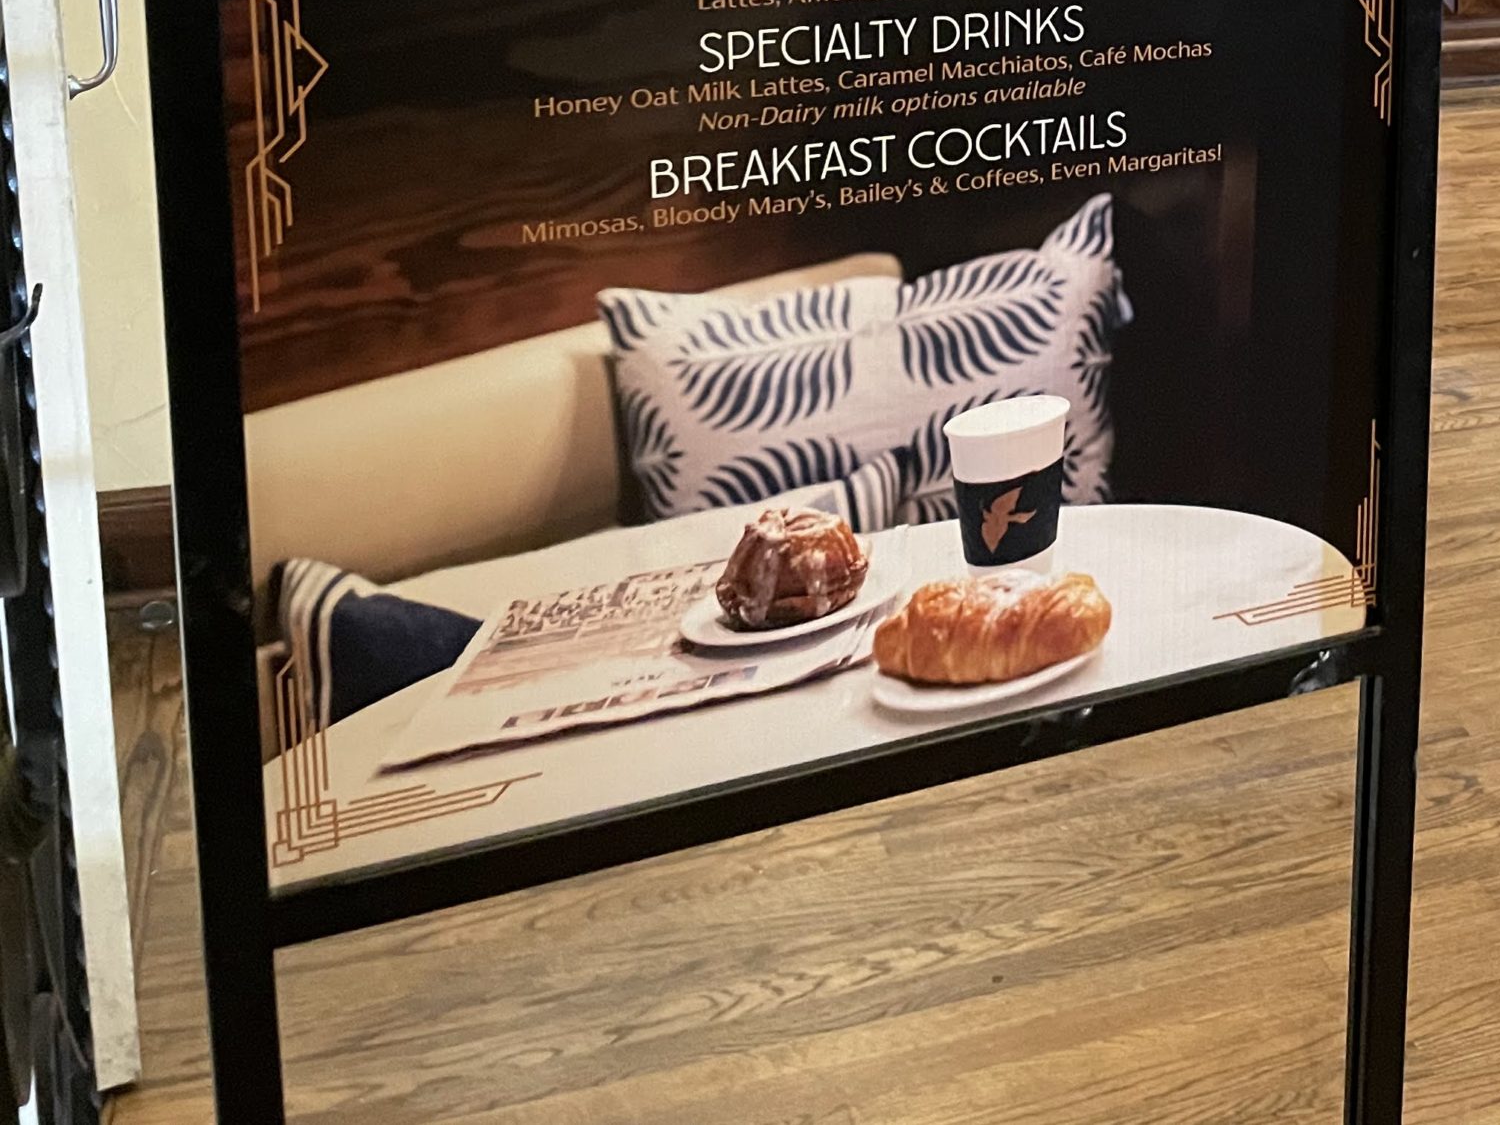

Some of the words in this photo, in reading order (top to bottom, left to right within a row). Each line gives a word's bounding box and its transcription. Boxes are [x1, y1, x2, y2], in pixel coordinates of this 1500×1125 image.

[699, 17, 917, 73] SPECIALTY
[933, 5, 1084, 53] DRINKS
[535, 96, 622, 117] Honey
[631, 87, 679, 108] Oat
[688, 81, 742, 103] Milk
[751, 77, 830, 97] Lattes,
[838, 63, 933, 89] Caramel
[942, 55, 1072, 80] Macchiatos,
[1080, 46, 1126, 67] Café
[1134, 41, 1212, 62] Mochas
[699, 103, 826, 131] Non-Dairy
[834, 96, 884, 119] milk
[891, 91, 977, 116] options
[984, 77, 1086, 104] available
[651, 135, 896, 198] BREAKFAST
[908, 111, 1126, 168] COCKTAILS
[522, 218, 643, 243] Mimosas,
[654, 201, 740, 227] Bloody
[749, 190, 831, 216] Mary's,
[840, 179, 922, 205] Bailey's
[930, 176, 949, 194] &
[956, 169, 1044, 191] Coffees,
[1052, 163, 1100, 180] Even
[1108, 144, 1221, 173] Margaritas!
